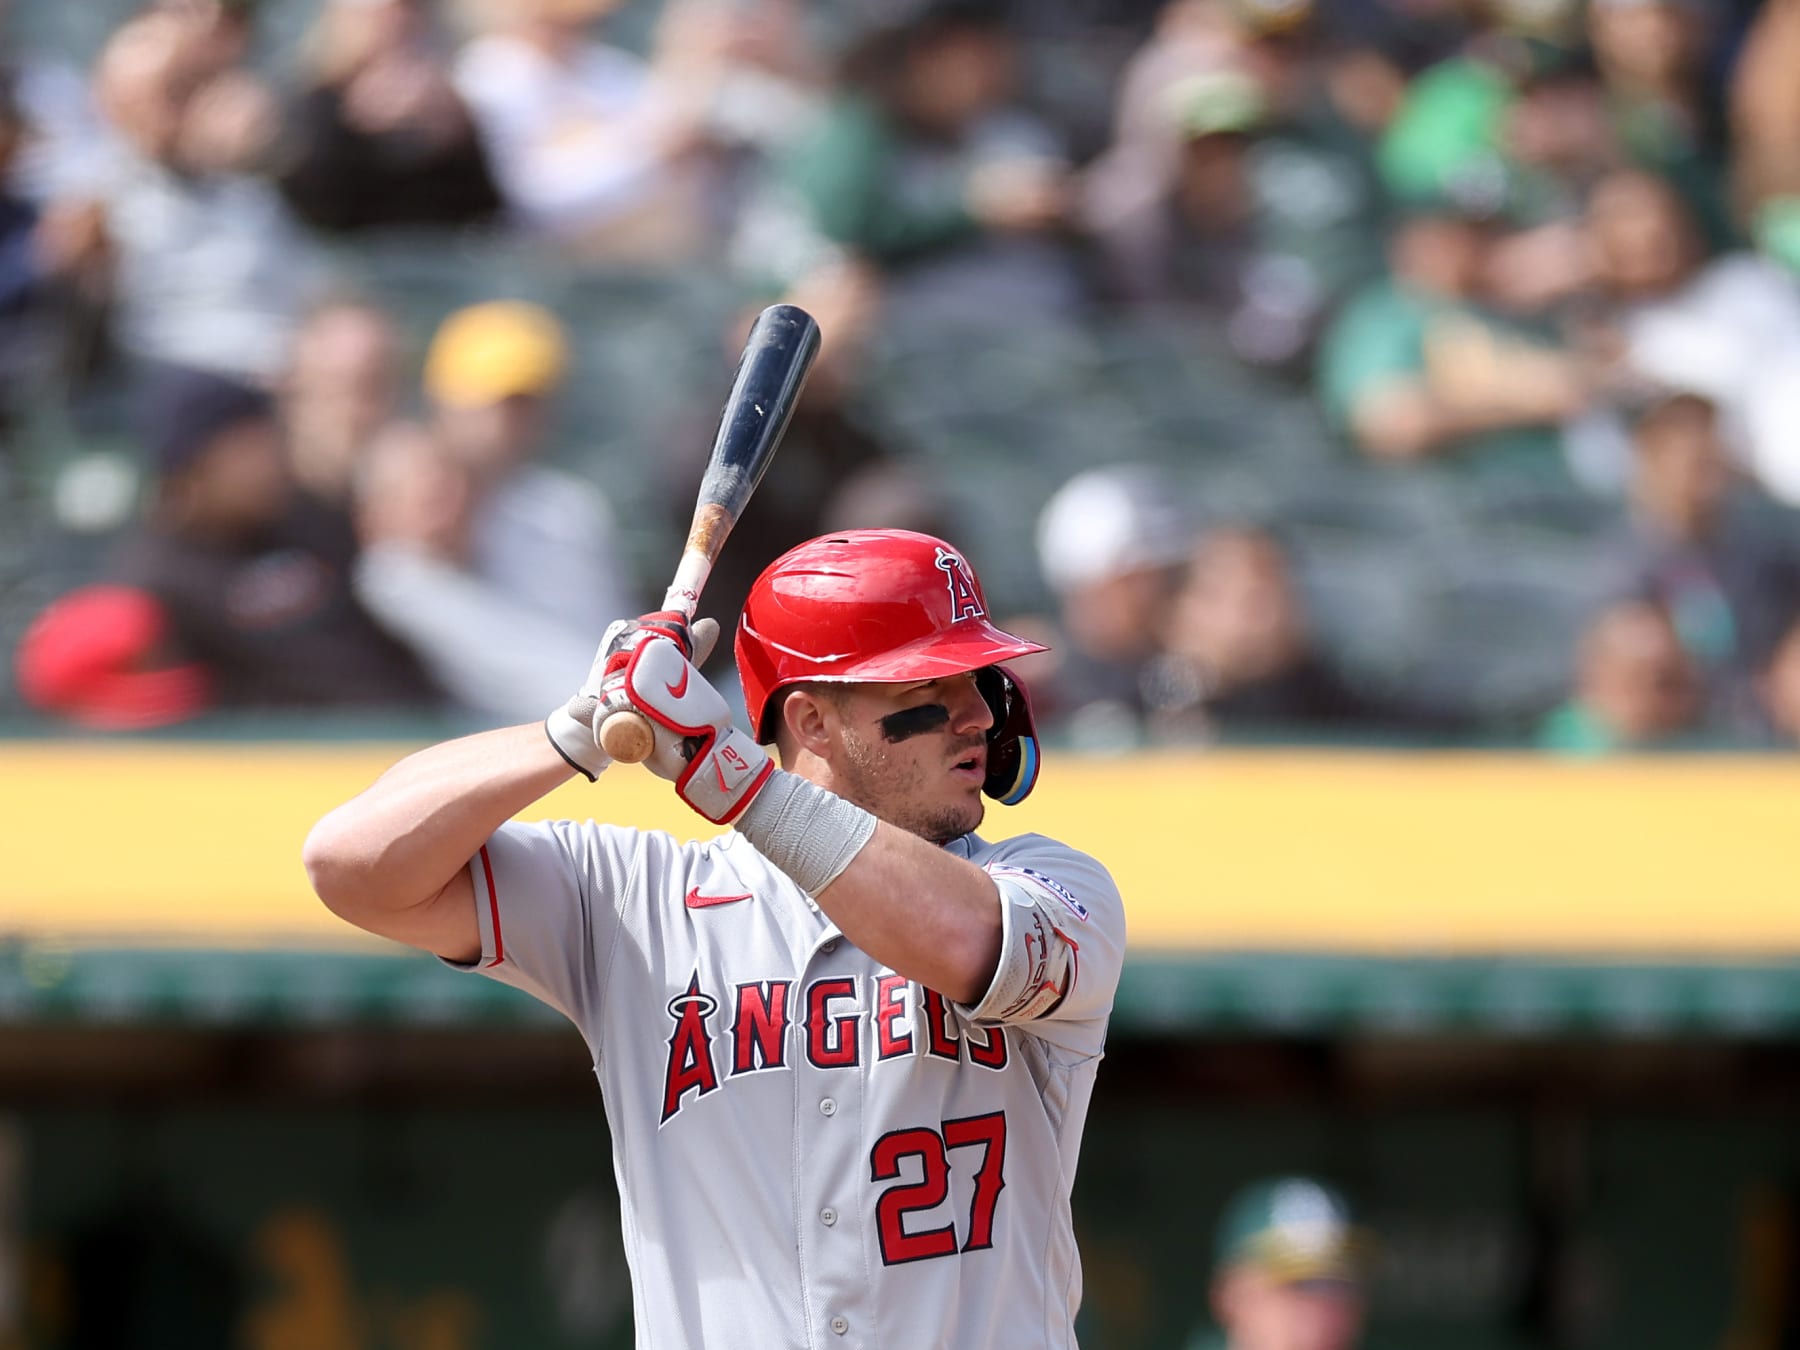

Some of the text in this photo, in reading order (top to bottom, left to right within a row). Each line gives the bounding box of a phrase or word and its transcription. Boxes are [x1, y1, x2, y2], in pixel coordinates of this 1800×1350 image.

[935, 547, 984, 624] A
[720, 744, 750, 772] 27
[870, 1110, 1007, 1266] 27
